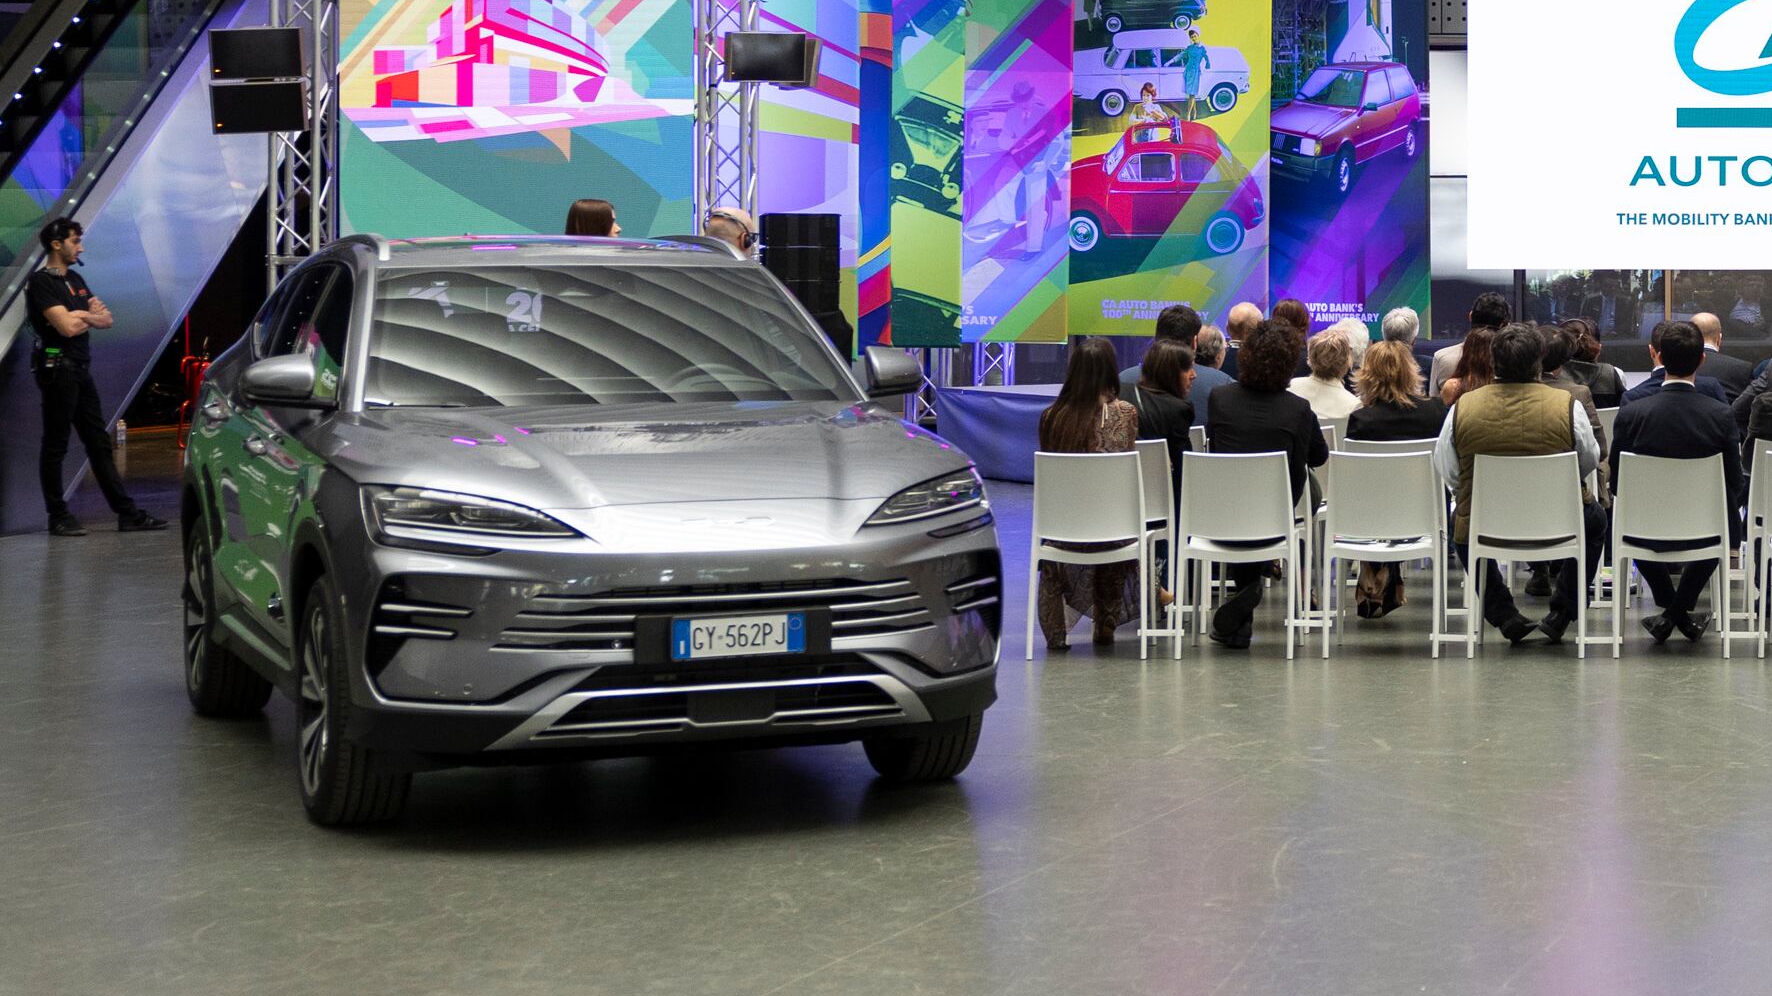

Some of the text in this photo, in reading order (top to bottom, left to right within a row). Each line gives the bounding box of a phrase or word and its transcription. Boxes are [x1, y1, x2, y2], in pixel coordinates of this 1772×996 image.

[1616, 213, 1648, 226] THE
[1652, 213, 1730, 226] MOBILITY
[1119, 300, 1148, 310] AUTO
[1330, 303, 1364, 312] BANK'S
